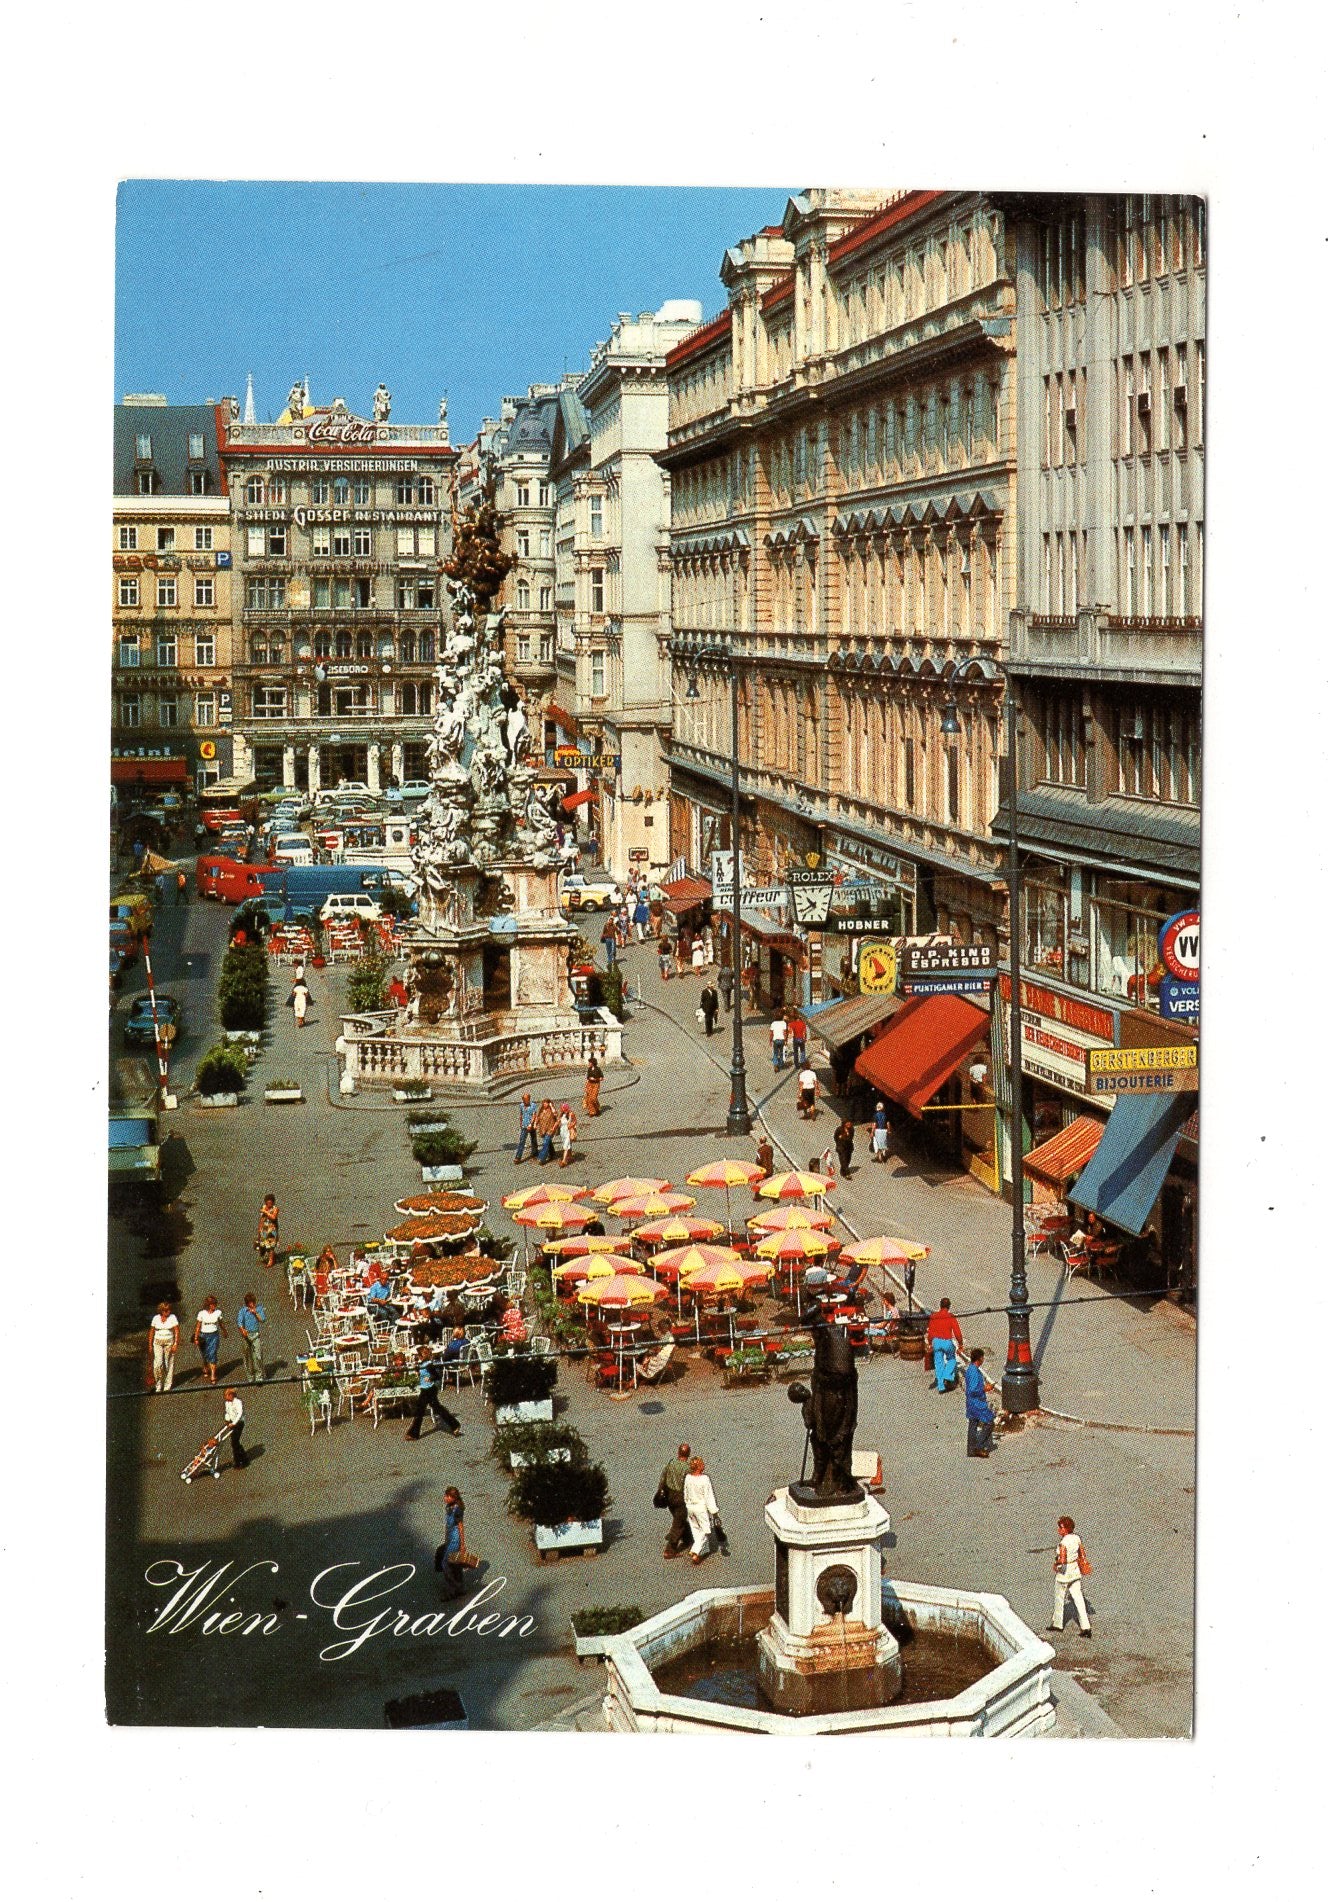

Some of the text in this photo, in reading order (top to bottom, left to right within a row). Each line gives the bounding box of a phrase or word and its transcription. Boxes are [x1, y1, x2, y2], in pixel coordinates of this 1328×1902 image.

[323, 459, 418, 472] VERSICHERUNGEN
[218, 553, 229, 565] P
[221, 693, 230, 706] P
[564, 755, 614, 767] OPTIKER
[792, 871, 834, 882] ROLEX
[948, 947, 991, 957] KINO
[911, 957, 991, 969] ESPRESSO
[913, 983, 963, 993] PUNTIGAMER
[1092, 1048, 1196, 1069] GERSTENBERGER
[1096, 1074, 1174, 1091] BIJOUTERIE
